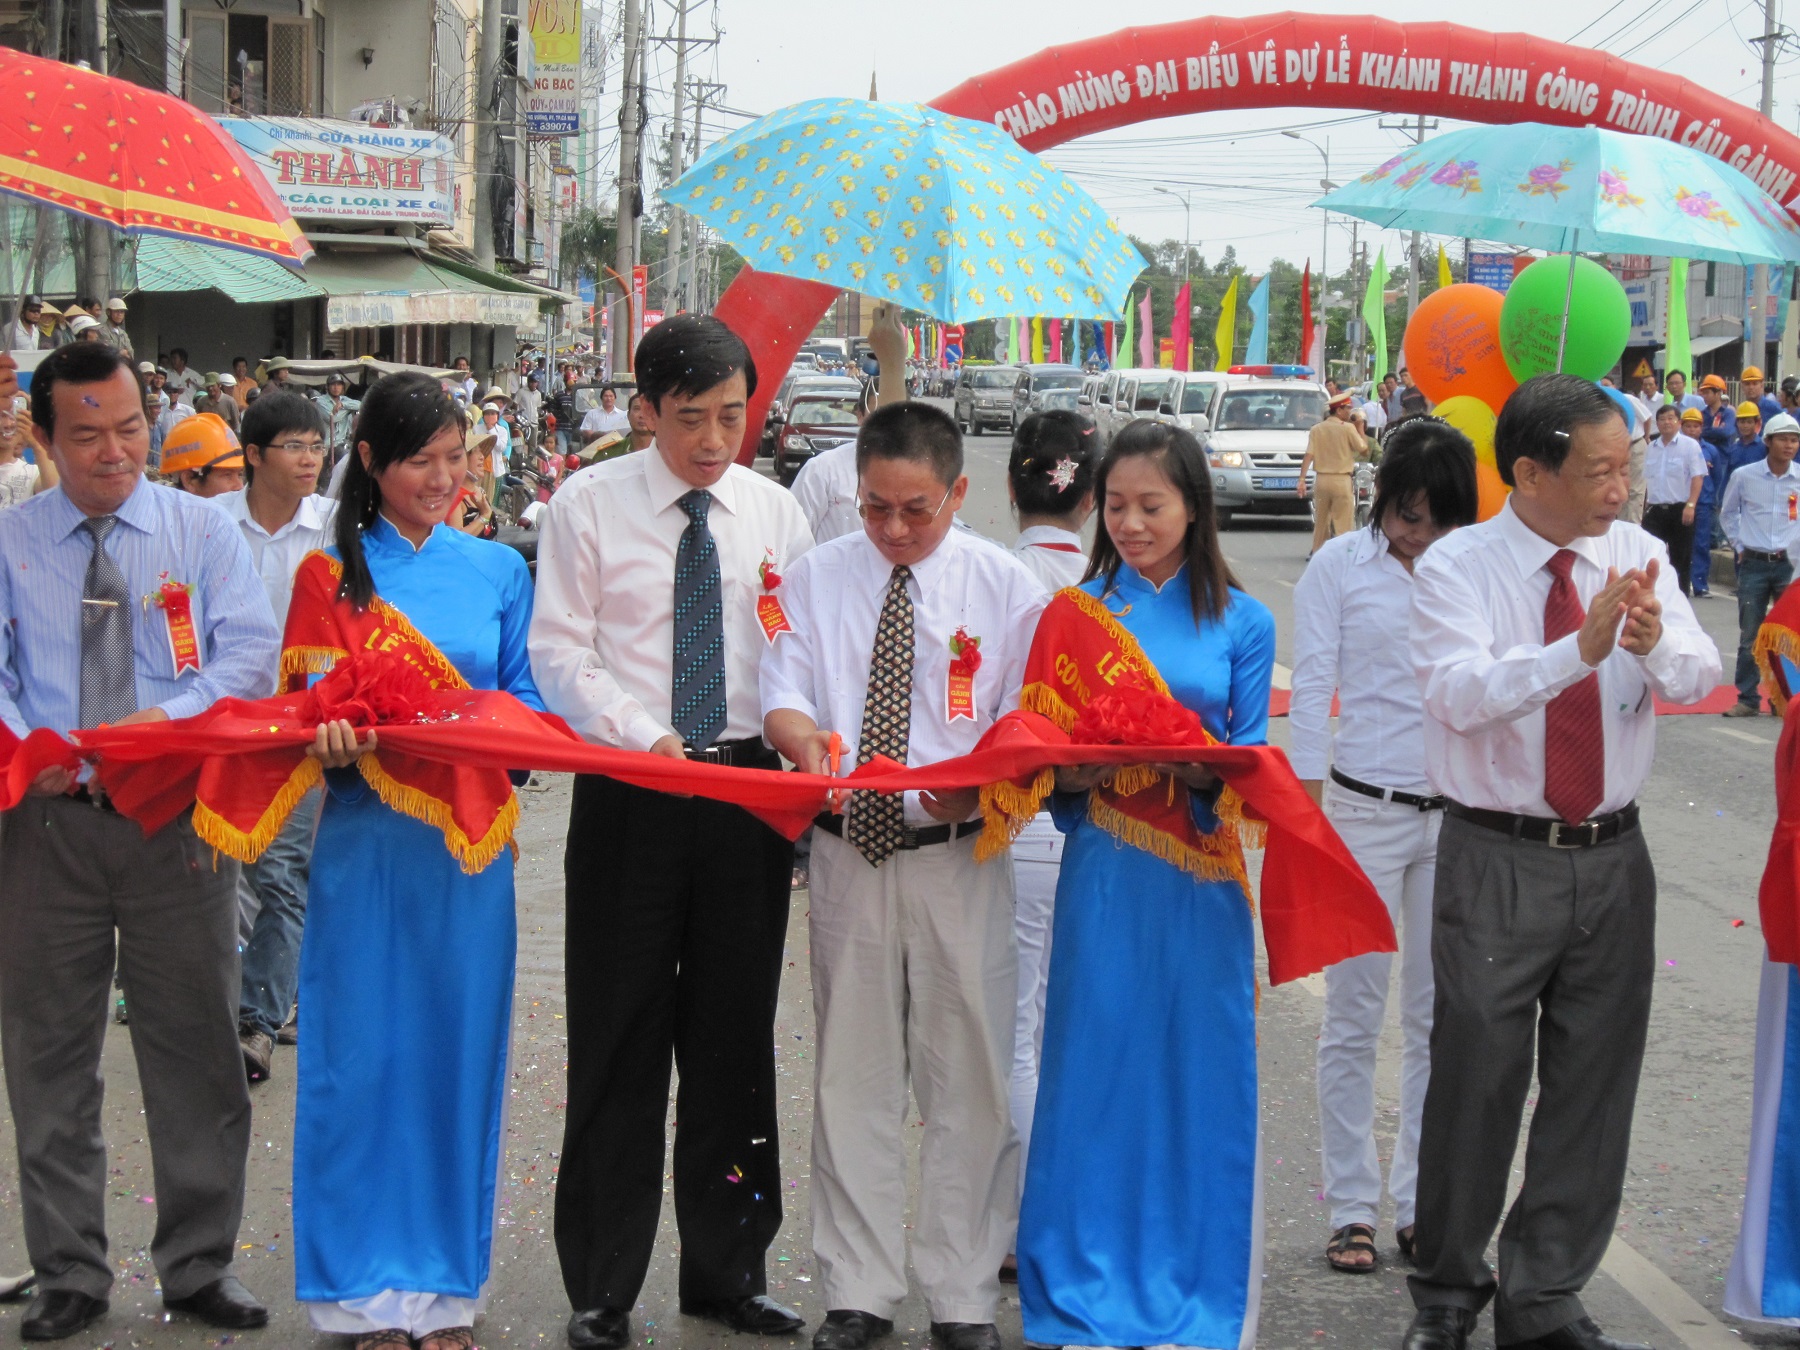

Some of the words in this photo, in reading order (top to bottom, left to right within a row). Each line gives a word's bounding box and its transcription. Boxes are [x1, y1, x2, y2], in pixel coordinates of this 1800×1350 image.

[553, 78, 575, 92] BẠC
[994, 91, 1058, 139] CHÀO
[1058, 70, 1131, 119] MỪNG
[1136, 59, 1179, 101] ĐẠI
[1186, 40, 1239, 91] BIỂU
[1248, 39, 1277, 84] VỀ
[1285, 41, 1320, 90] DỰ
[1326, 34, 1350, 84] LỄ
[1358, 48, 1441, 92] KHÁNH
[1449, 60, 1527, 103] THÀNH
[1535, 67, 1599, 117] CÔNG
[1606, 89, 1680, 140] TRÌNH
[358, 132, 405, 147] HÀNG
[410, 137, 432, 149] XE
[271, 147, 424, 191] THÀNH
[340, 196, 389, 209] LOẠI
[396, 199, 423, 209] XE
